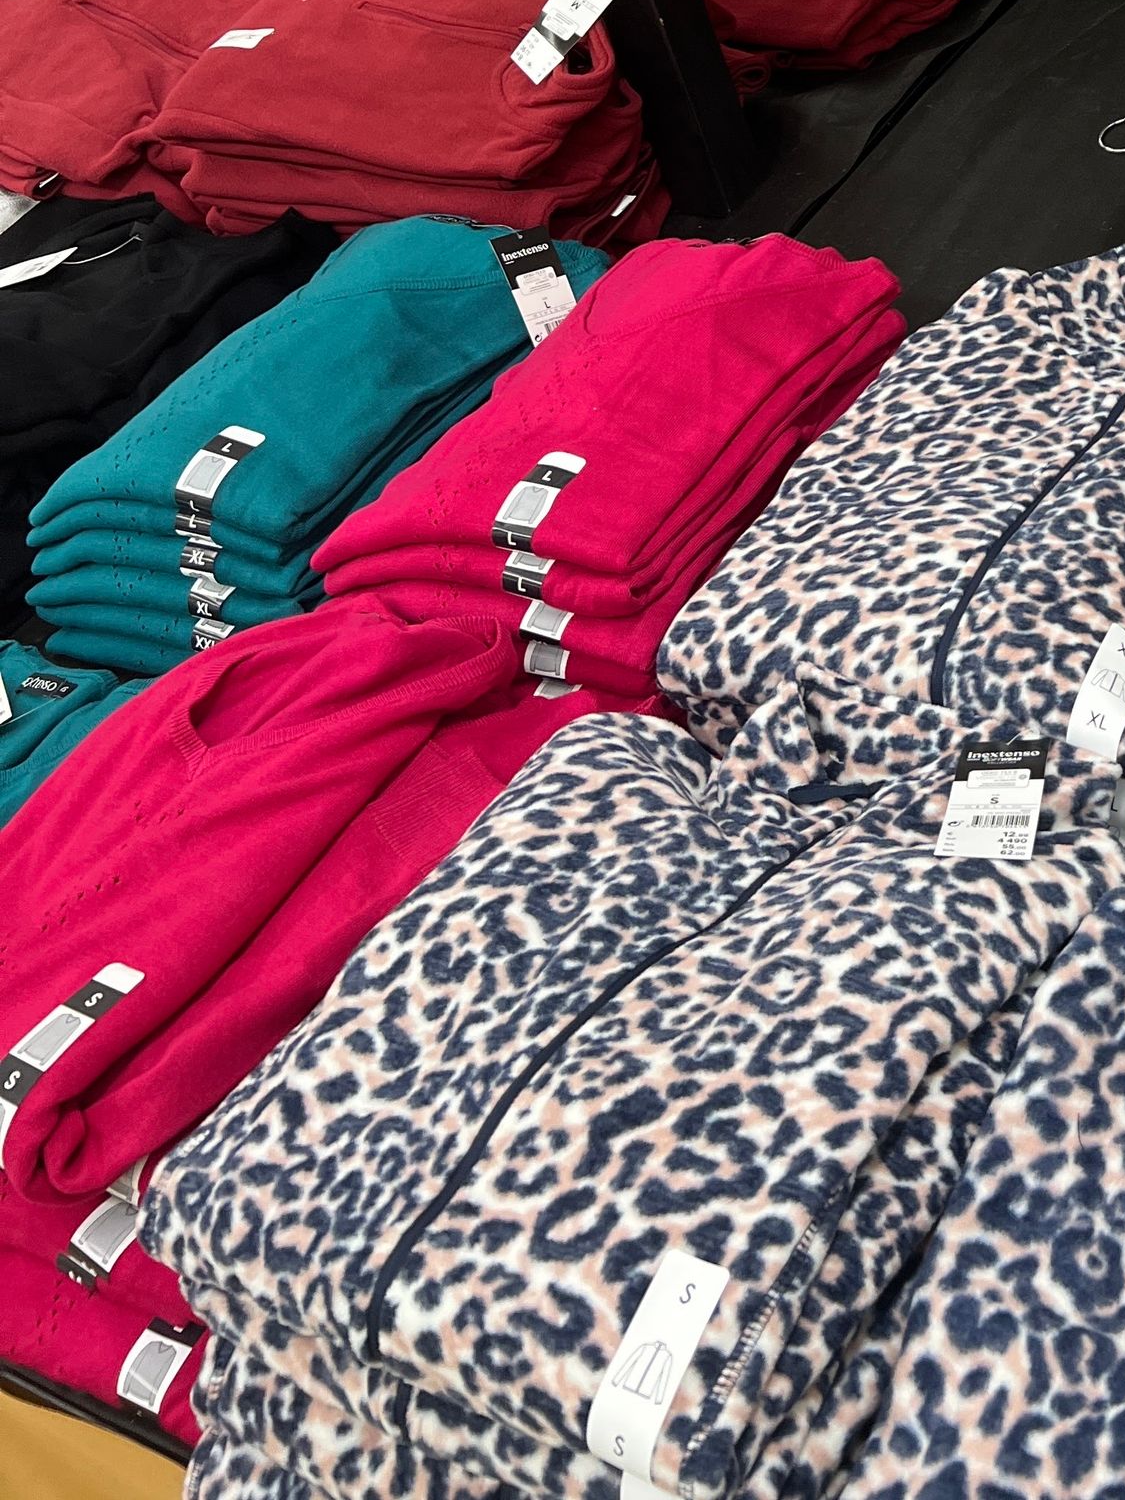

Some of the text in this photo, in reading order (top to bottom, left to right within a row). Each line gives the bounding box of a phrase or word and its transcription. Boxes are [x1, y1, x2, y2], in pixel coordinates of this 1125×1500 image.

[501, 243, 549, 262] Inextenso
[221, 442, 233, 453] L
[542, 470, 553, 481] L
[188, 514, 197, 529] L
[507, 531, 517, 546] L
[188, 550, 206, 566] XL
[517, 576, 526, 593] L
[196, 601, 213, 617] XL
[1086, 711, 1107, 731] XL
[967, 750, 1040, 760] Inextenso
[85, 992, 103, 1007] S
[3, 1070, 20, 1091] S
[679, 1283, 695, 1304] S
[613, 1435, 624, 1457] S
